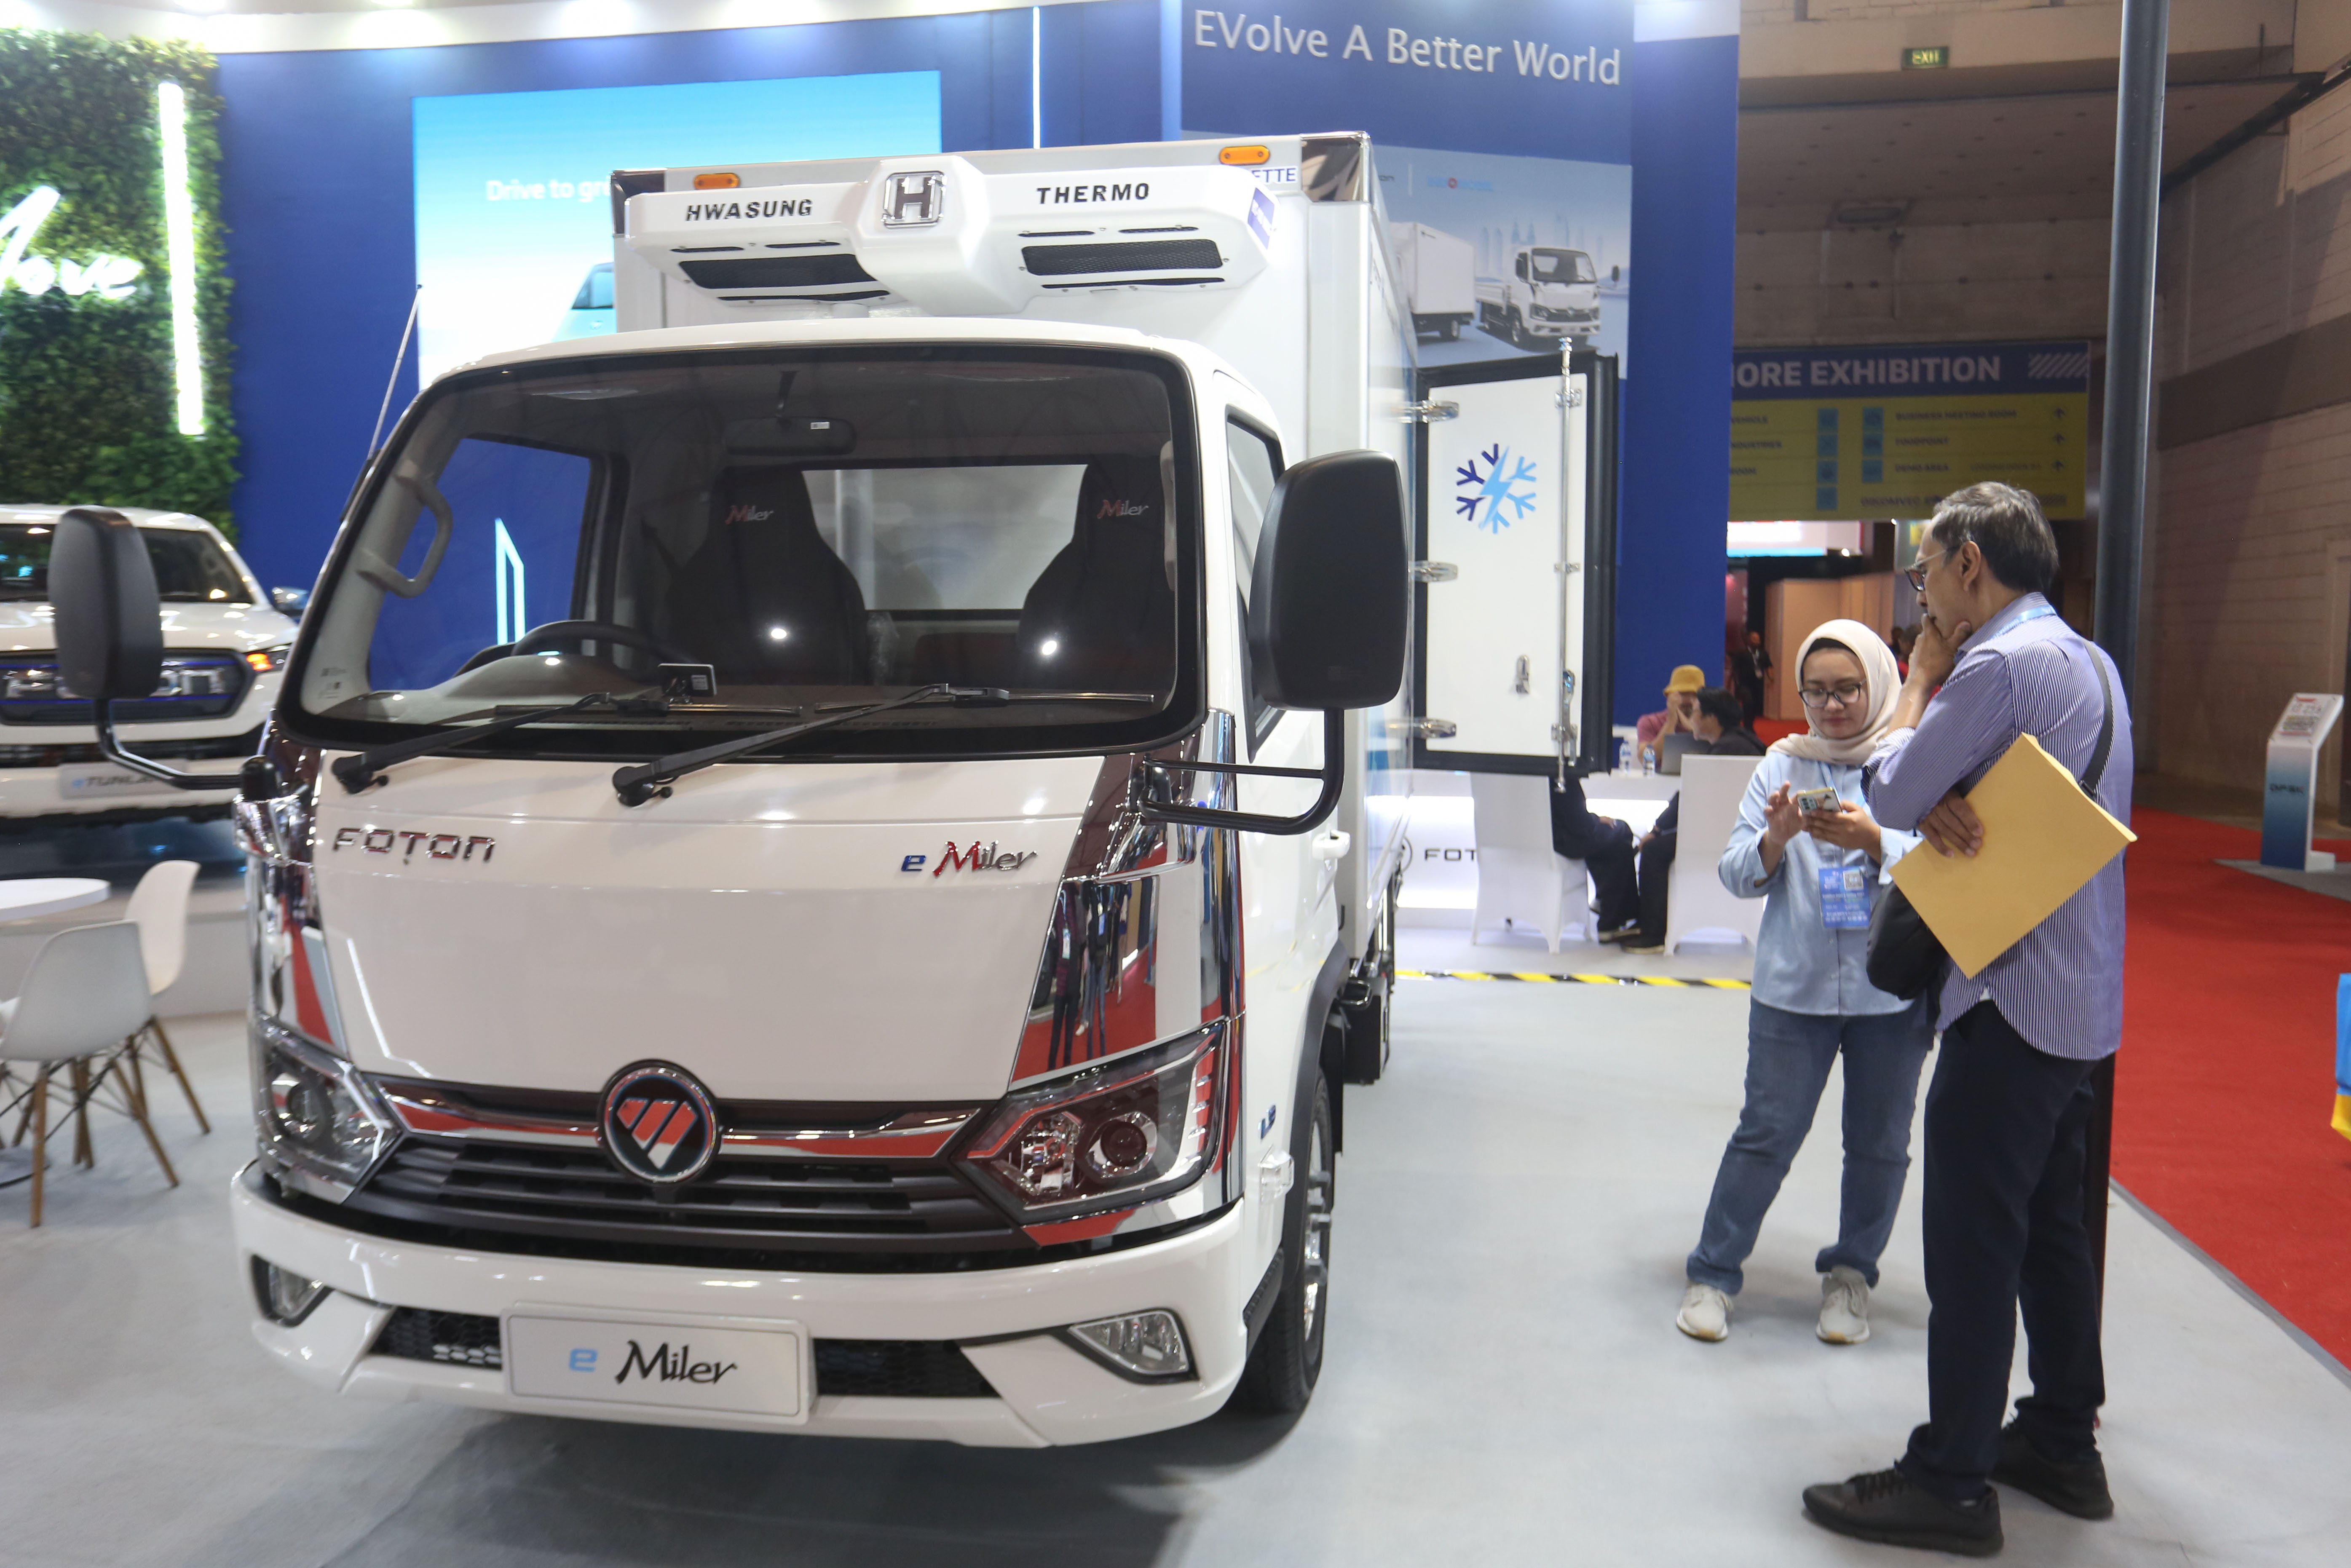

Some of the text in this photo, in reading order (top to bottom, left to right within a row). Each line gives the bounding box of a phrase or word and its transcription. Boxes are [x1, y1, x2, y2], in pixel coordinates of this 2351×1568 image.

[1194, 9, 1621, 85] EVolve A Better World
[1912, 50, 1939, 65] EXIT
[486, 179, 546, 201] Drive
[550, 179, 575, 198] to
[1036, 182, 1150, 205] THERMO
[685, 199, 813, 221] HWASUNG
[1731, 356, 2000, 388] ORE EXHIBITION
[725, 505, 774, 524] Miler
[1097, 499, 1149, 519] Miler
[332, 827, 497, 862] FOTON
[901, 840, 1038, 877] e Miler
[569, 1339, 738, 1385] e Miler
